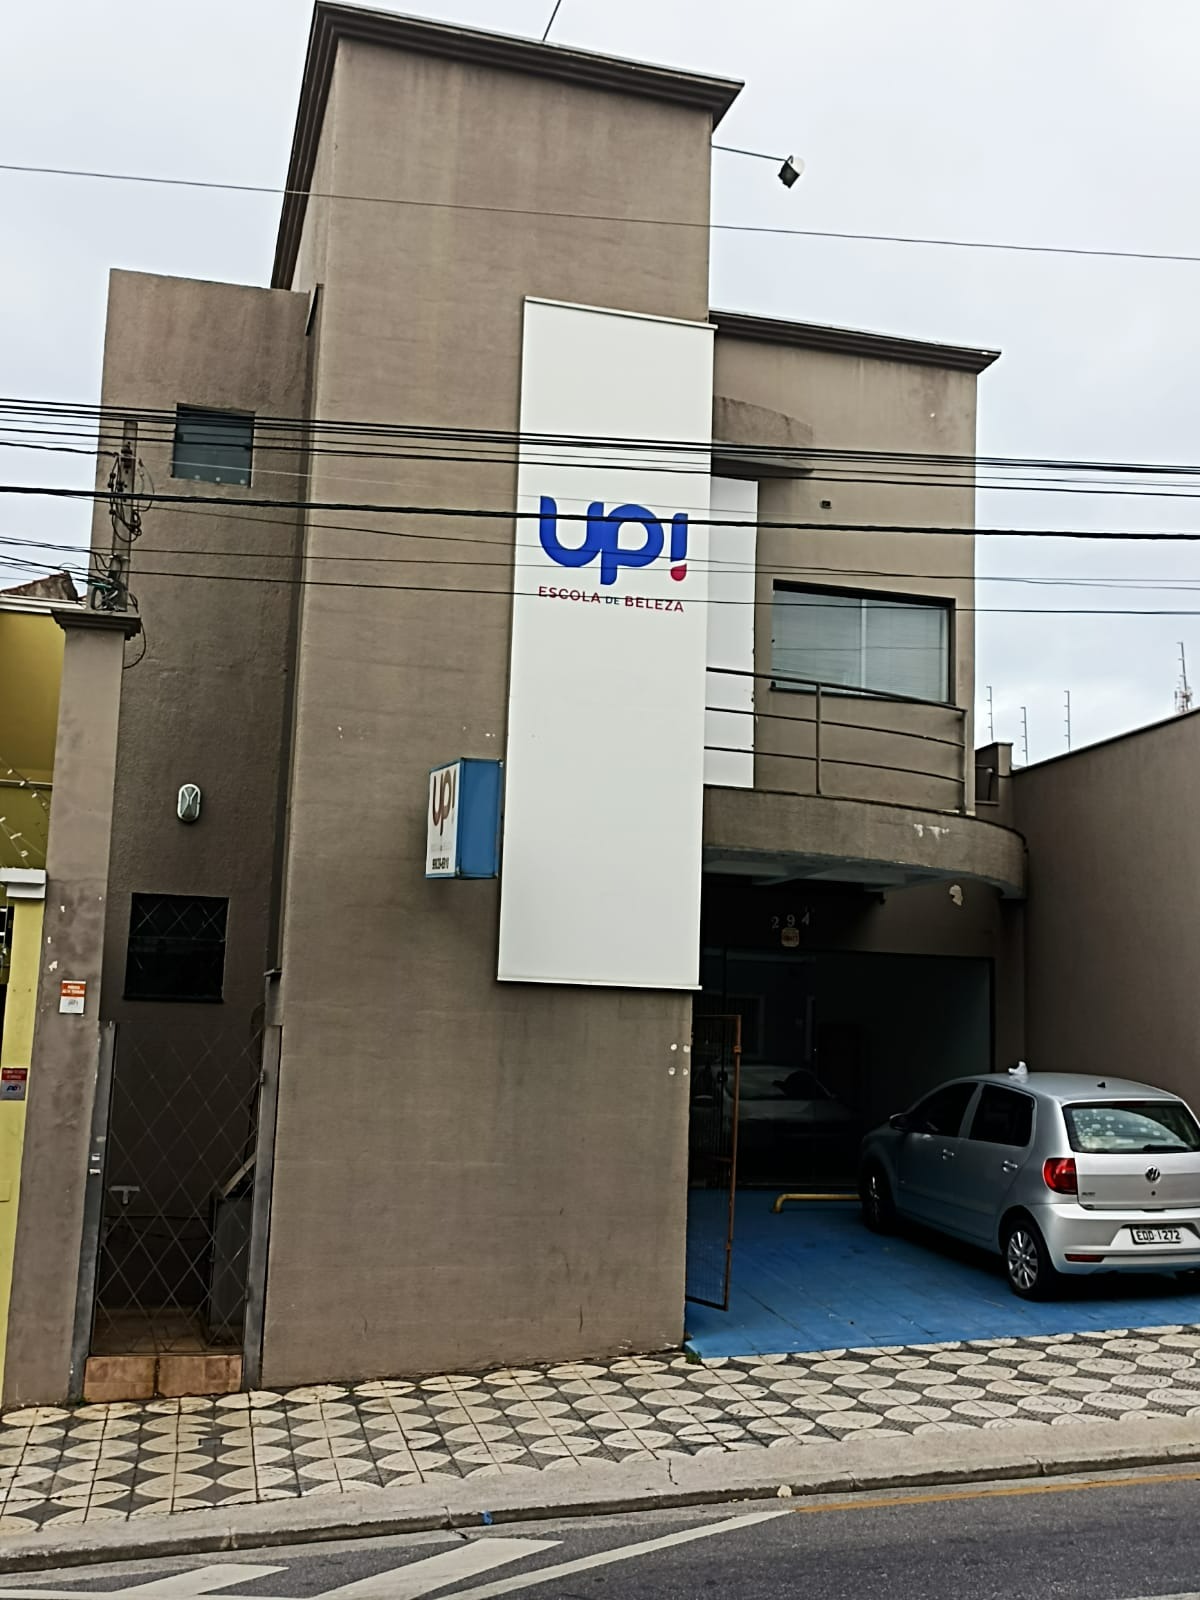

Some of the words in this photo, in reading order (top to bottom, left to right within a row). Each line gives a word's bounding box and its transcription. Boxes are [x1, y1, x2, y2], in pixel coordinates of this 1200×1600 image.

[538, 586, 601, 605] ESCOLA
[605, 596, 620, 606] DE
[624, 595, 685, 613] BELEZA
